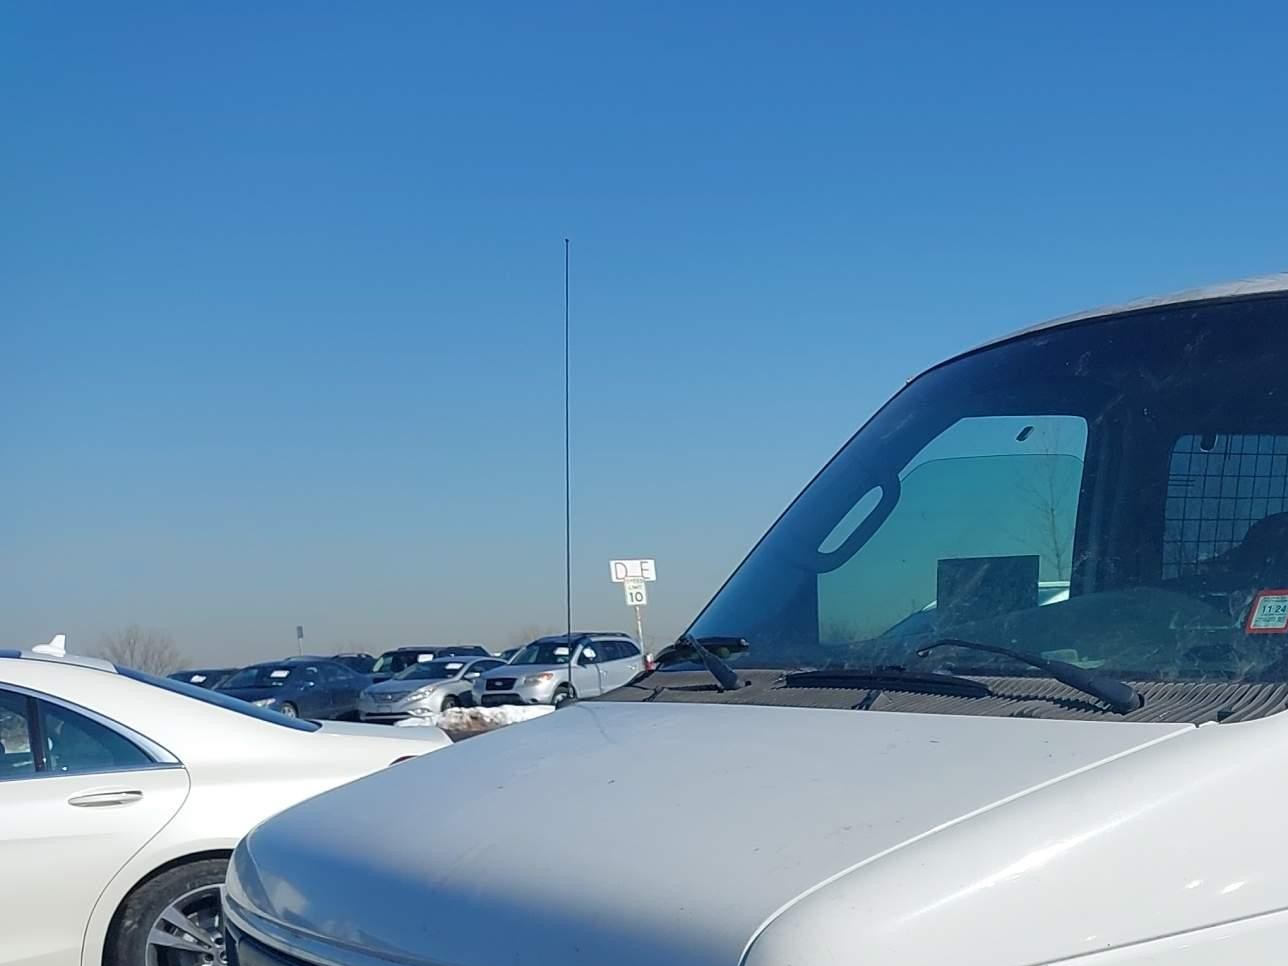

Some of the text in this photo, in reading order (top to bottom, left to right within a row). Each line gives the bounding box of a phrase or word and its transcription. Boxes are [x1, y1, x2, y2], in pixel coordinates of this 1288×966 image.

[614, 561, 651, 580] D E
[630, 591, 644, 603] 10
